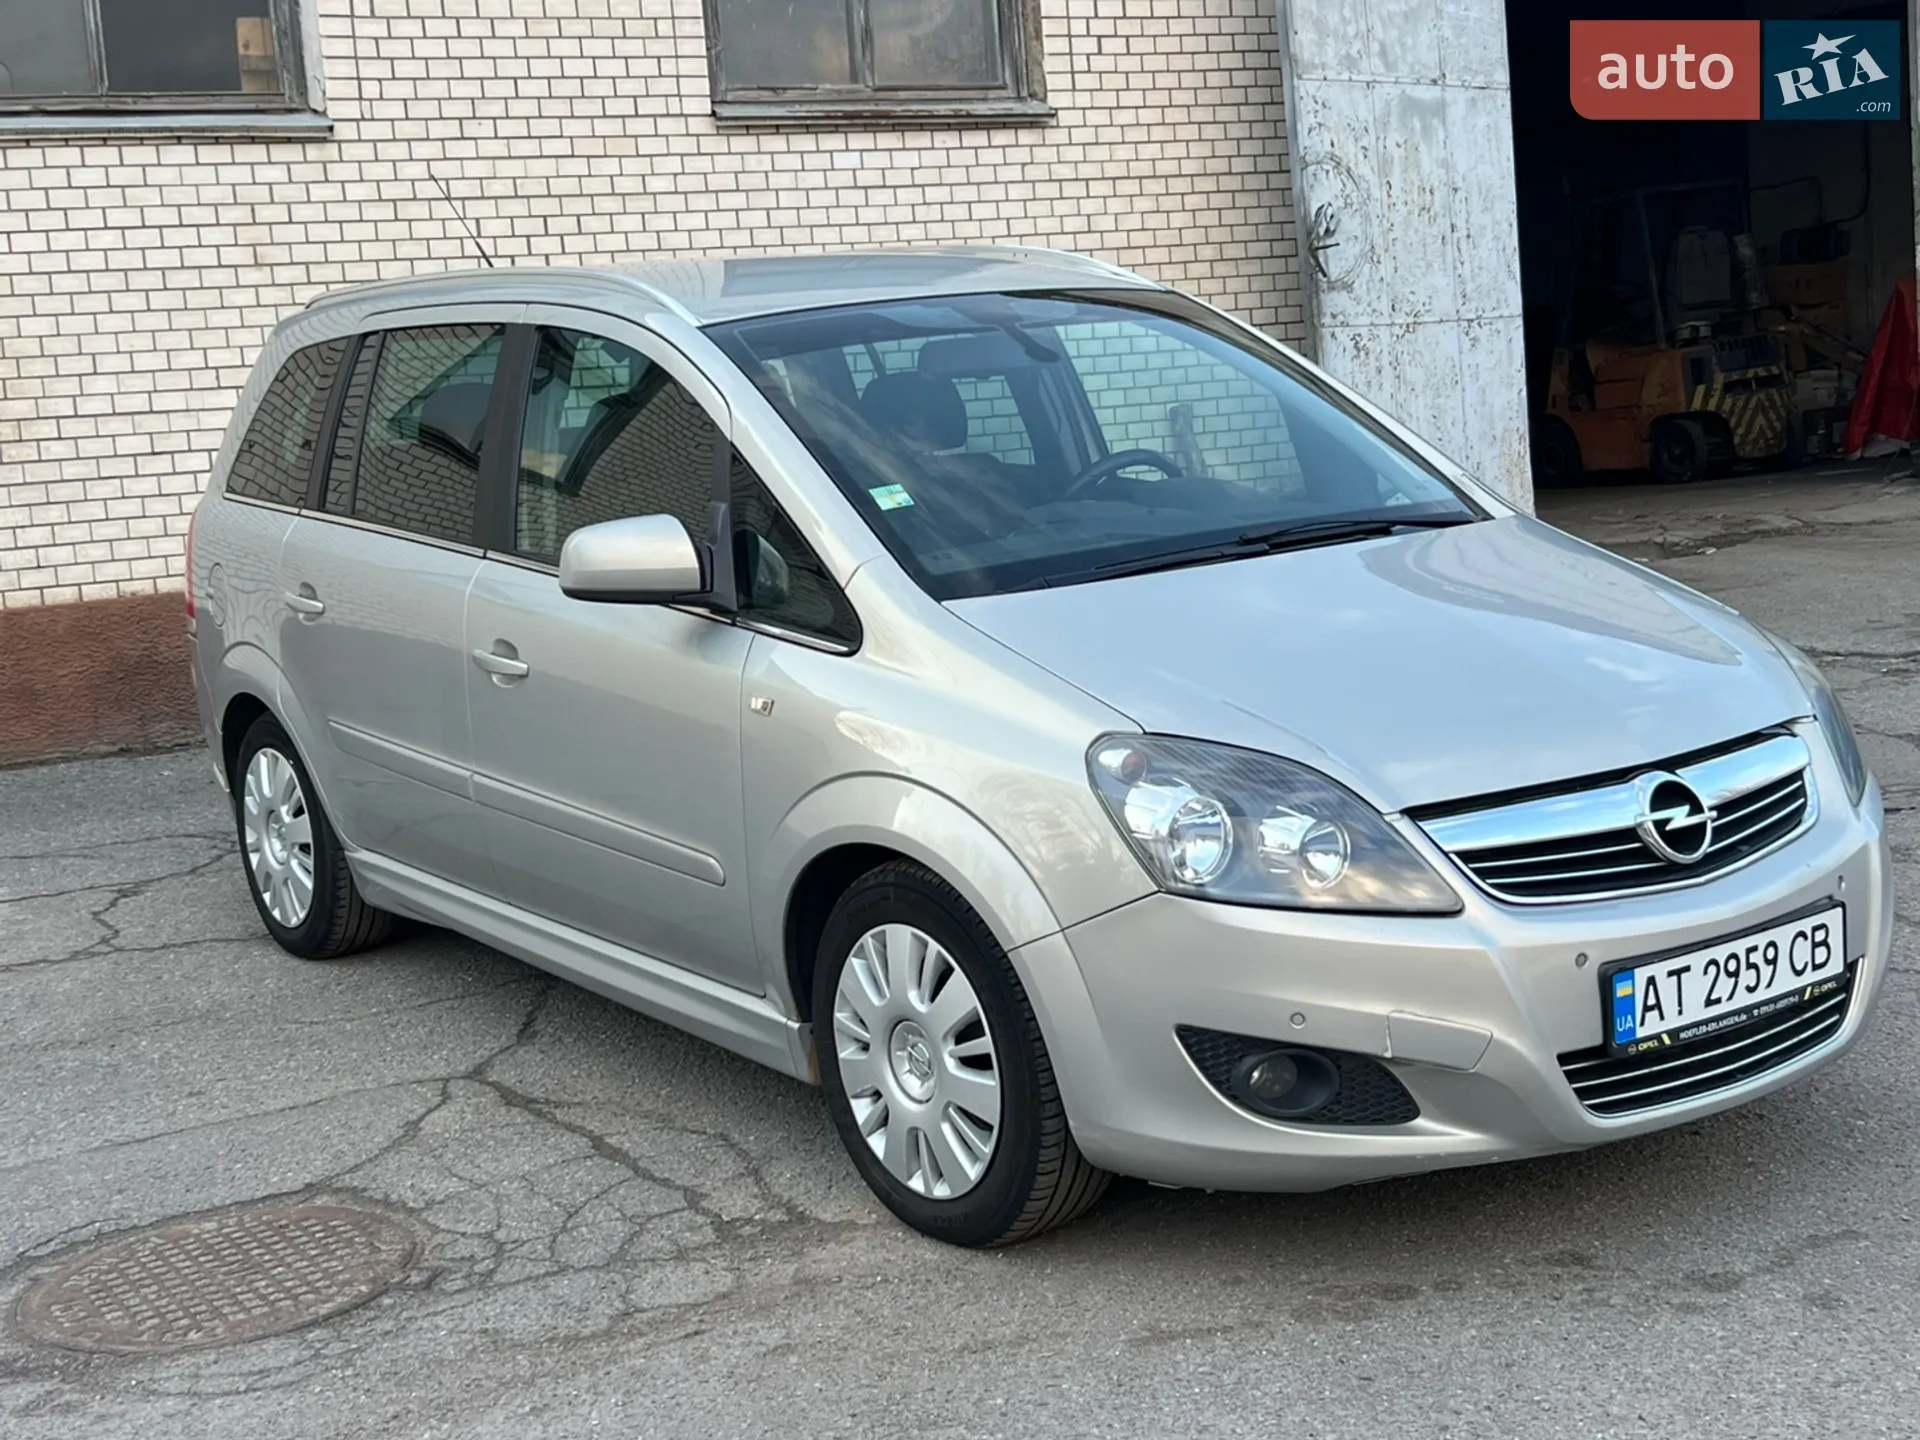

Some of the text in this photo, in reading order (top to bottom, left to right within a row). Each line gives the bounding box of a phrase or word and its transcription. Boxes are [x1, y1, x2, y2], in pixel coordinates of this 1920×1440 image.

[1639, 922, 1832, 1028] AT 2959 CB
[1616, 1014, 1634, 1032] UA
